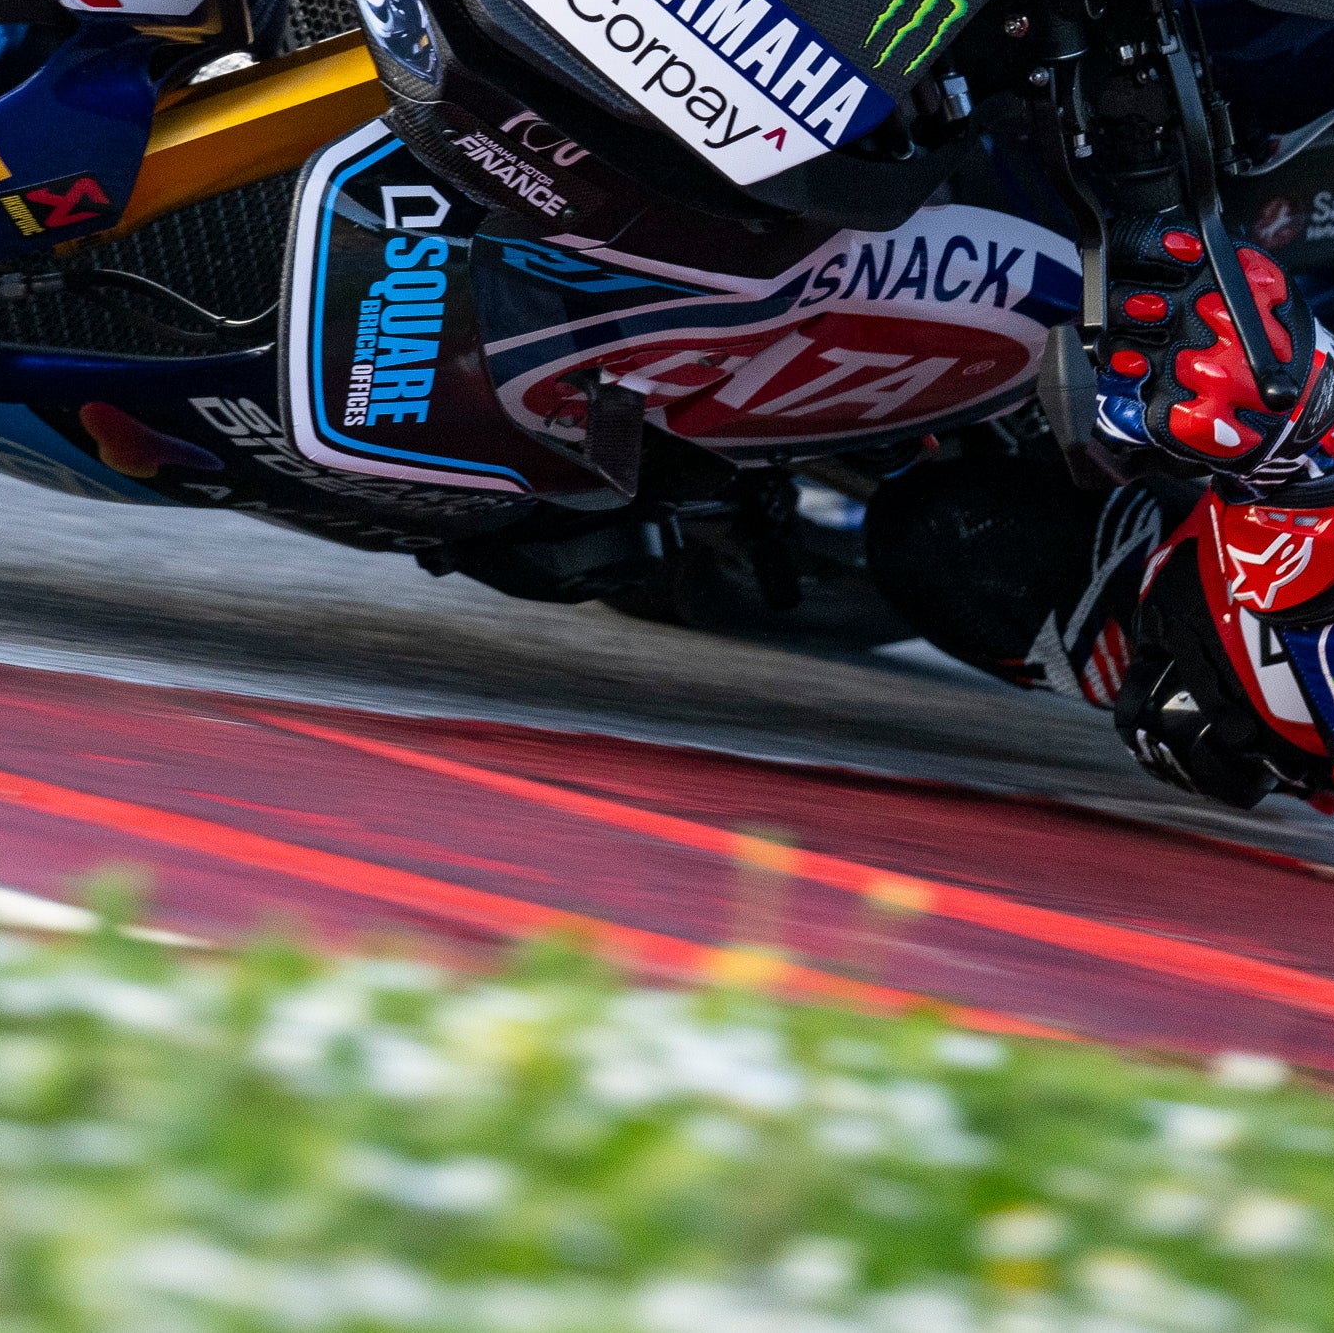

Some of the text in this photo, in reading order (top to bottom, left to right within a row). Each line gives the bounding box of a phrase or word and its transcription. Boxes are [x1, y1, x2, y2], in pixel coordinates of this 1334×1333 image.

[450, 135, 567, 217] FINANCE
[473, 131, 554, 187] YAMAHA MOTOR
[797, 235, 1025, 309] SNACK
[343, 299, 381, 427] BRICK OFFICES
[365, 236, 450, 427] SQUARE
